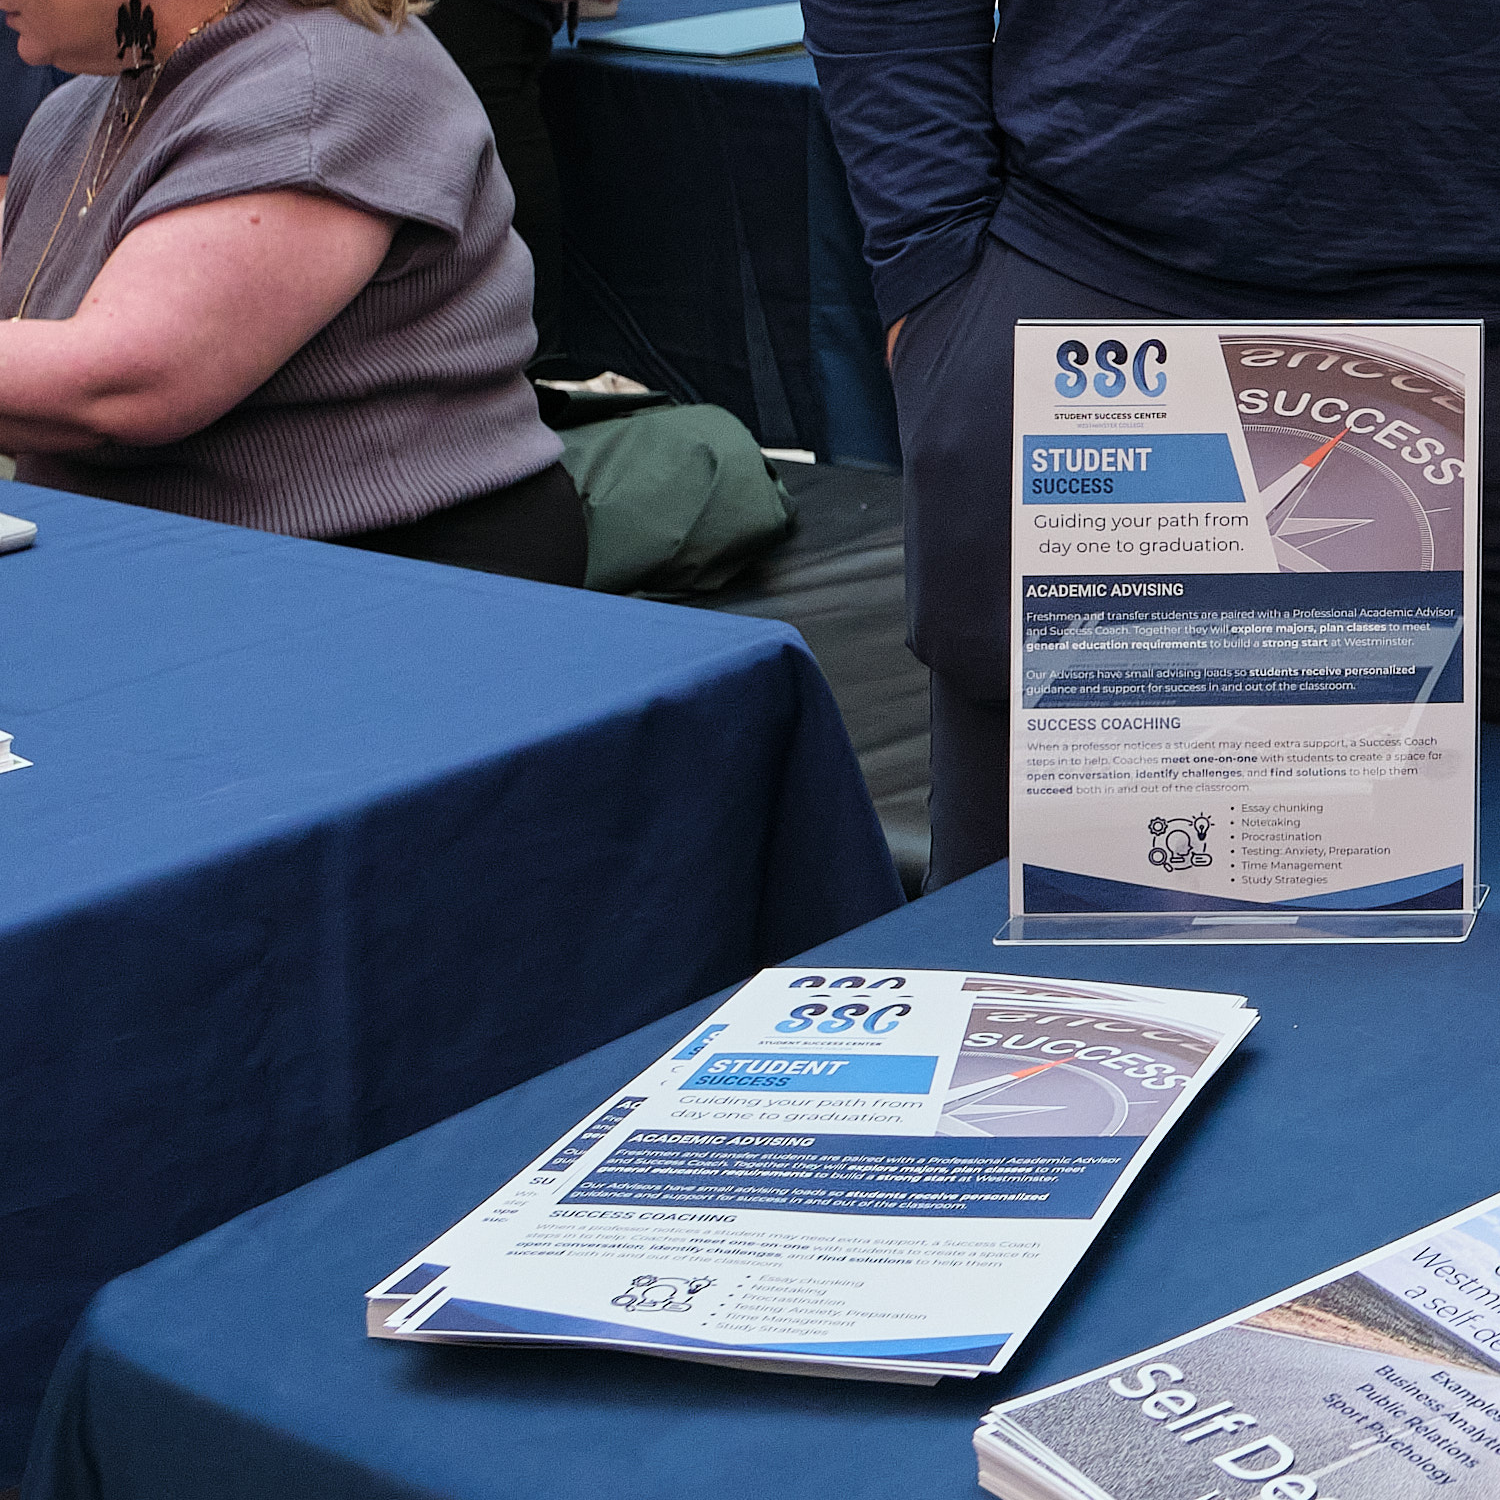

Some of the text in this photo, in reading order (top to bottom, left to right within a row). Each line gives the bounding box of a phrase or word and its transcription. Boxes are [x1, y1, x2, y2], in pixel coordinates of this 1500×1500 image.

[1054, 339, 1167, 398] SSC
[1094, 412, 1132, 420] SUCCESS
[1134, 412, 1167, 420] CENTER
[1238, 388, 1465, 487] SUCCESS
[1031, 447, 1153, 473] STUDENT
[1031, 477, 1114, 495] SUCCESS
[1034, 512, 1249, 532] Guiding your path from
[1038, 536, 1244, 557] day one to graduation.
[1025, 582, 1184, 598] ACADEMIC ADVISING
[1027, 716, 1181, 731] SUCCESS COACHING
[1241, 802, 1324, 815] Essay chunking
[1241, 817, 1301, 829] Notetaking
[1241, 831, 1322, 842] Procrastination
[1241, 845, 1391, 858] Testing: Anxiety, Preparation
[1241, 860, 1343, 872] Time Management
[1241, 875, 1328, 887] Study Strategies
[774, 1002, 912, 1035] SSC
[707, 1059, 850, 1076] STUDENT
[965, 1032, 1192, 1092] SUCCESS
[694, 1075, 792, 1087] SUCCESS
[679, 1095, 923, 1109] Guiding your path from
[670, 1109, 710, 1120] day
[758, 1112, 780, 1120] to
[784, 1112, 903, 1123] graduation.
[627, 1133, 816, 1147] ACADEMIC ADVISING
[1404, 1285, 1422, 1299] a
[1374, 1364, 1442, 1414] Business
[1108, 1363, 1256, 1443] Self
[1355, 1382, 1480, 1469] Public Relations
[1322, 1393, 1369, 1425] Sport
[1365, 1422, 1458, 1486] Psychology
